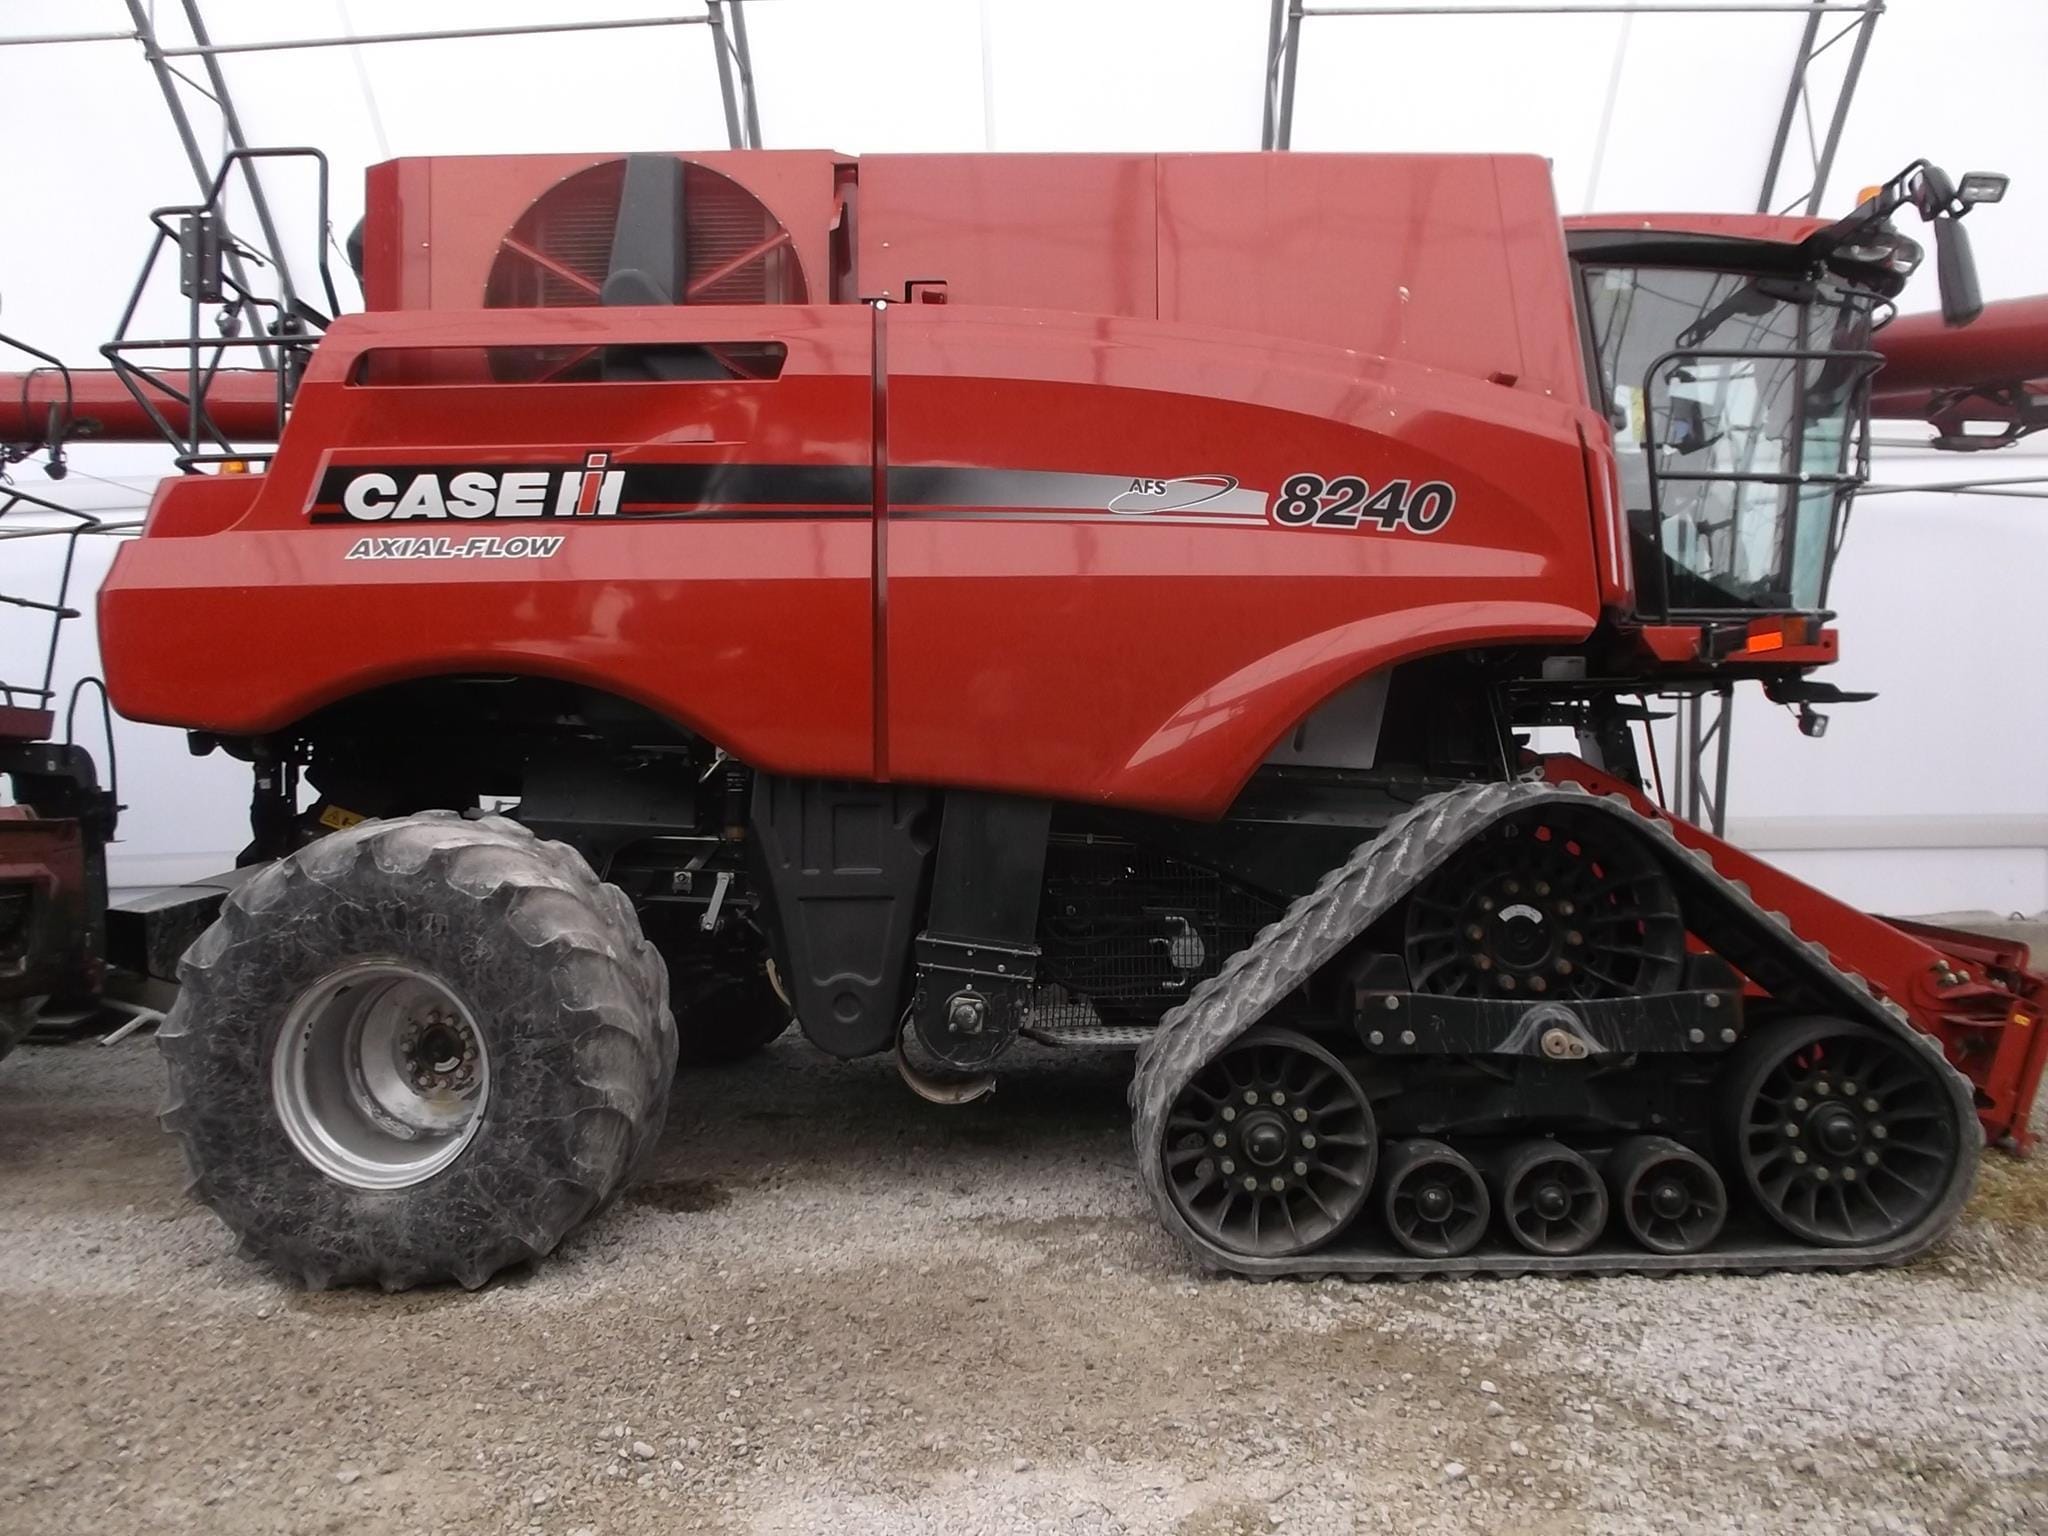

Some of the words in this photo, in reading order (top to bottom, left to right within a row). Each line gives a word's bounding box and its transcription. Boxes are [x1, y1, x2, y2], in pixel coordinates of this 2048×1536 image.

[344, 472, 550, 520] CASE
[1128, 478, 1167, 496] AFS
[1272, 473, 1456, 535] 8240
[345, 536, 565, 560] AXIAL-FLOW
